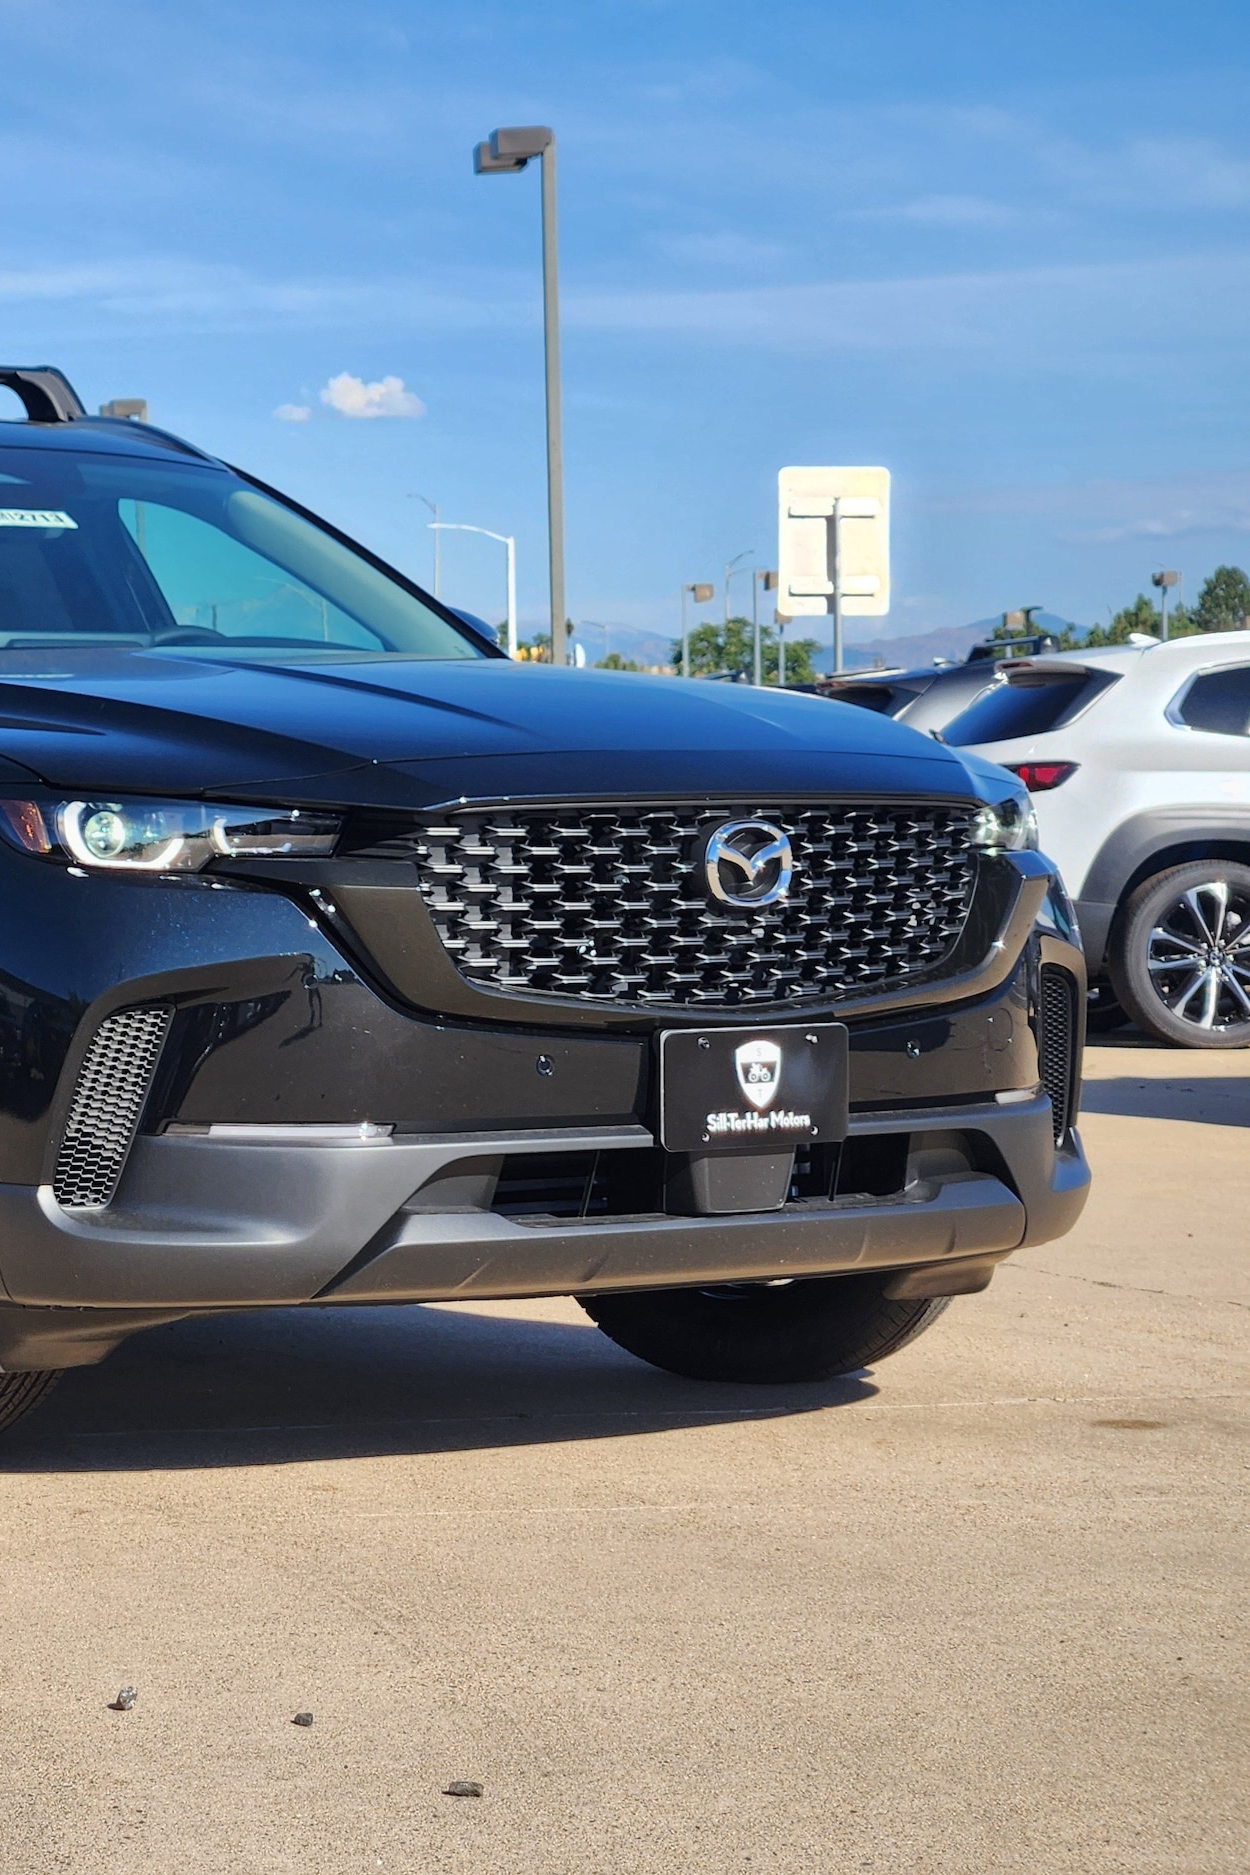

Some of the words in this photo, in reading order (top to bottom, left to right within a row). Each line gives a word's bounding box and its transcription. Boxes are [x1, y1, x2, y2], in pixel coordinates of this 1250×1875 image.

[756, 1048, 762, 1057] S
[757, 1089, 764, 1098] T
[706, 1111, 770, 1132] Sill-TerHar
[770, 1109, 812, 1129] Motors
